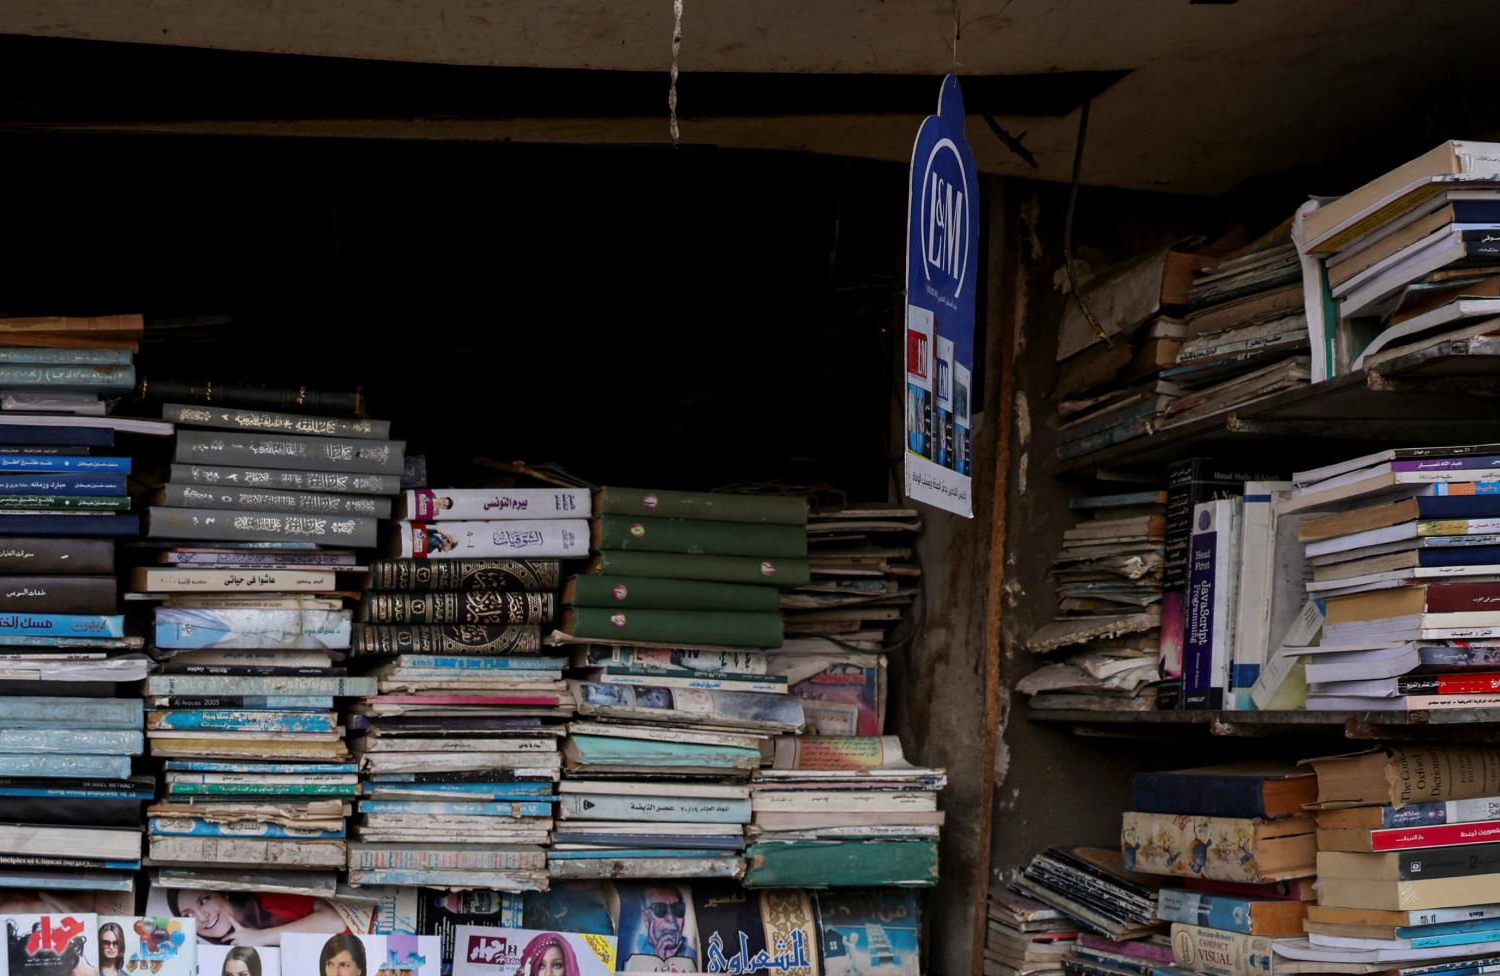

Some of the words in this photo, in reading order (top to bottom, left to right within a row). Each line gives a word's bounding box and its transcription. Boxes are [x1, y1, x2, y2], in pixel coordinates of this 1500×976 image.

[928, 171, 962, 281] L&M
[511, 498, 528, 511] بيرم
[224, 574, 245, 586] حياتى
[258, 575, 276, 585] عاشوا
[1197, 579, 1211, 645] JavaScript
[21, 617, 53, 629] مسك
[707, 928, 811, 976] الشعراوى
[1198, 948, 1232, 966] VISUAL
